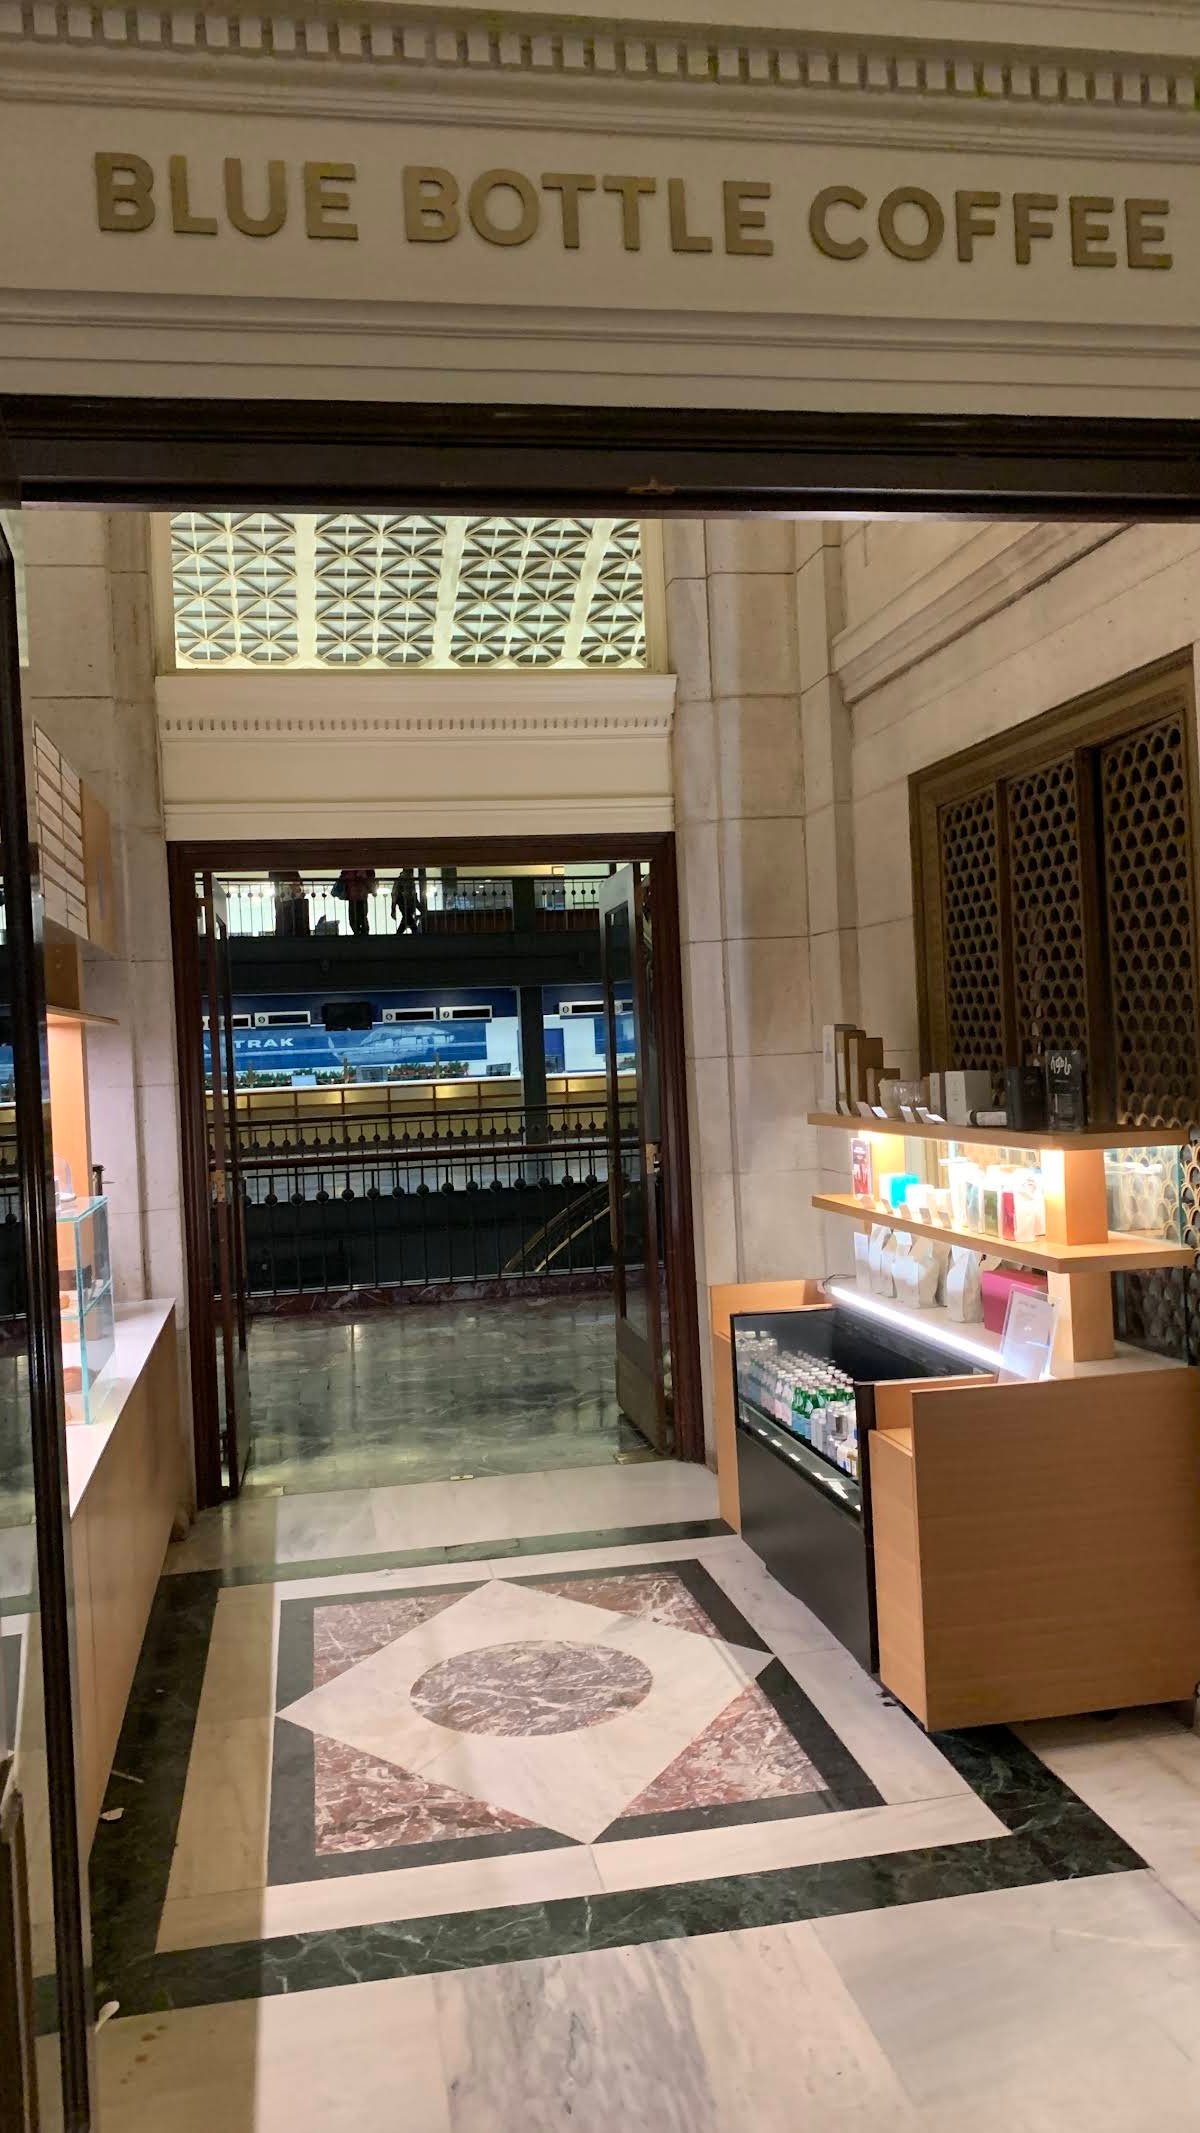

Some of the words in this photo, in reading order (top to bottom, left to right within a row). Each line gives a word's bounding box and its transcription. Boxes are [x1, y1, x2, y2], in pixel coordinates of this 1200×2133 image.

[95, 152, 359, 241] BLUE
[403, 166, 774, 256] BOTTLE
[808, 185, 1174, 269] COFFEE
[204, 1037, 295, 1050] TRAK
